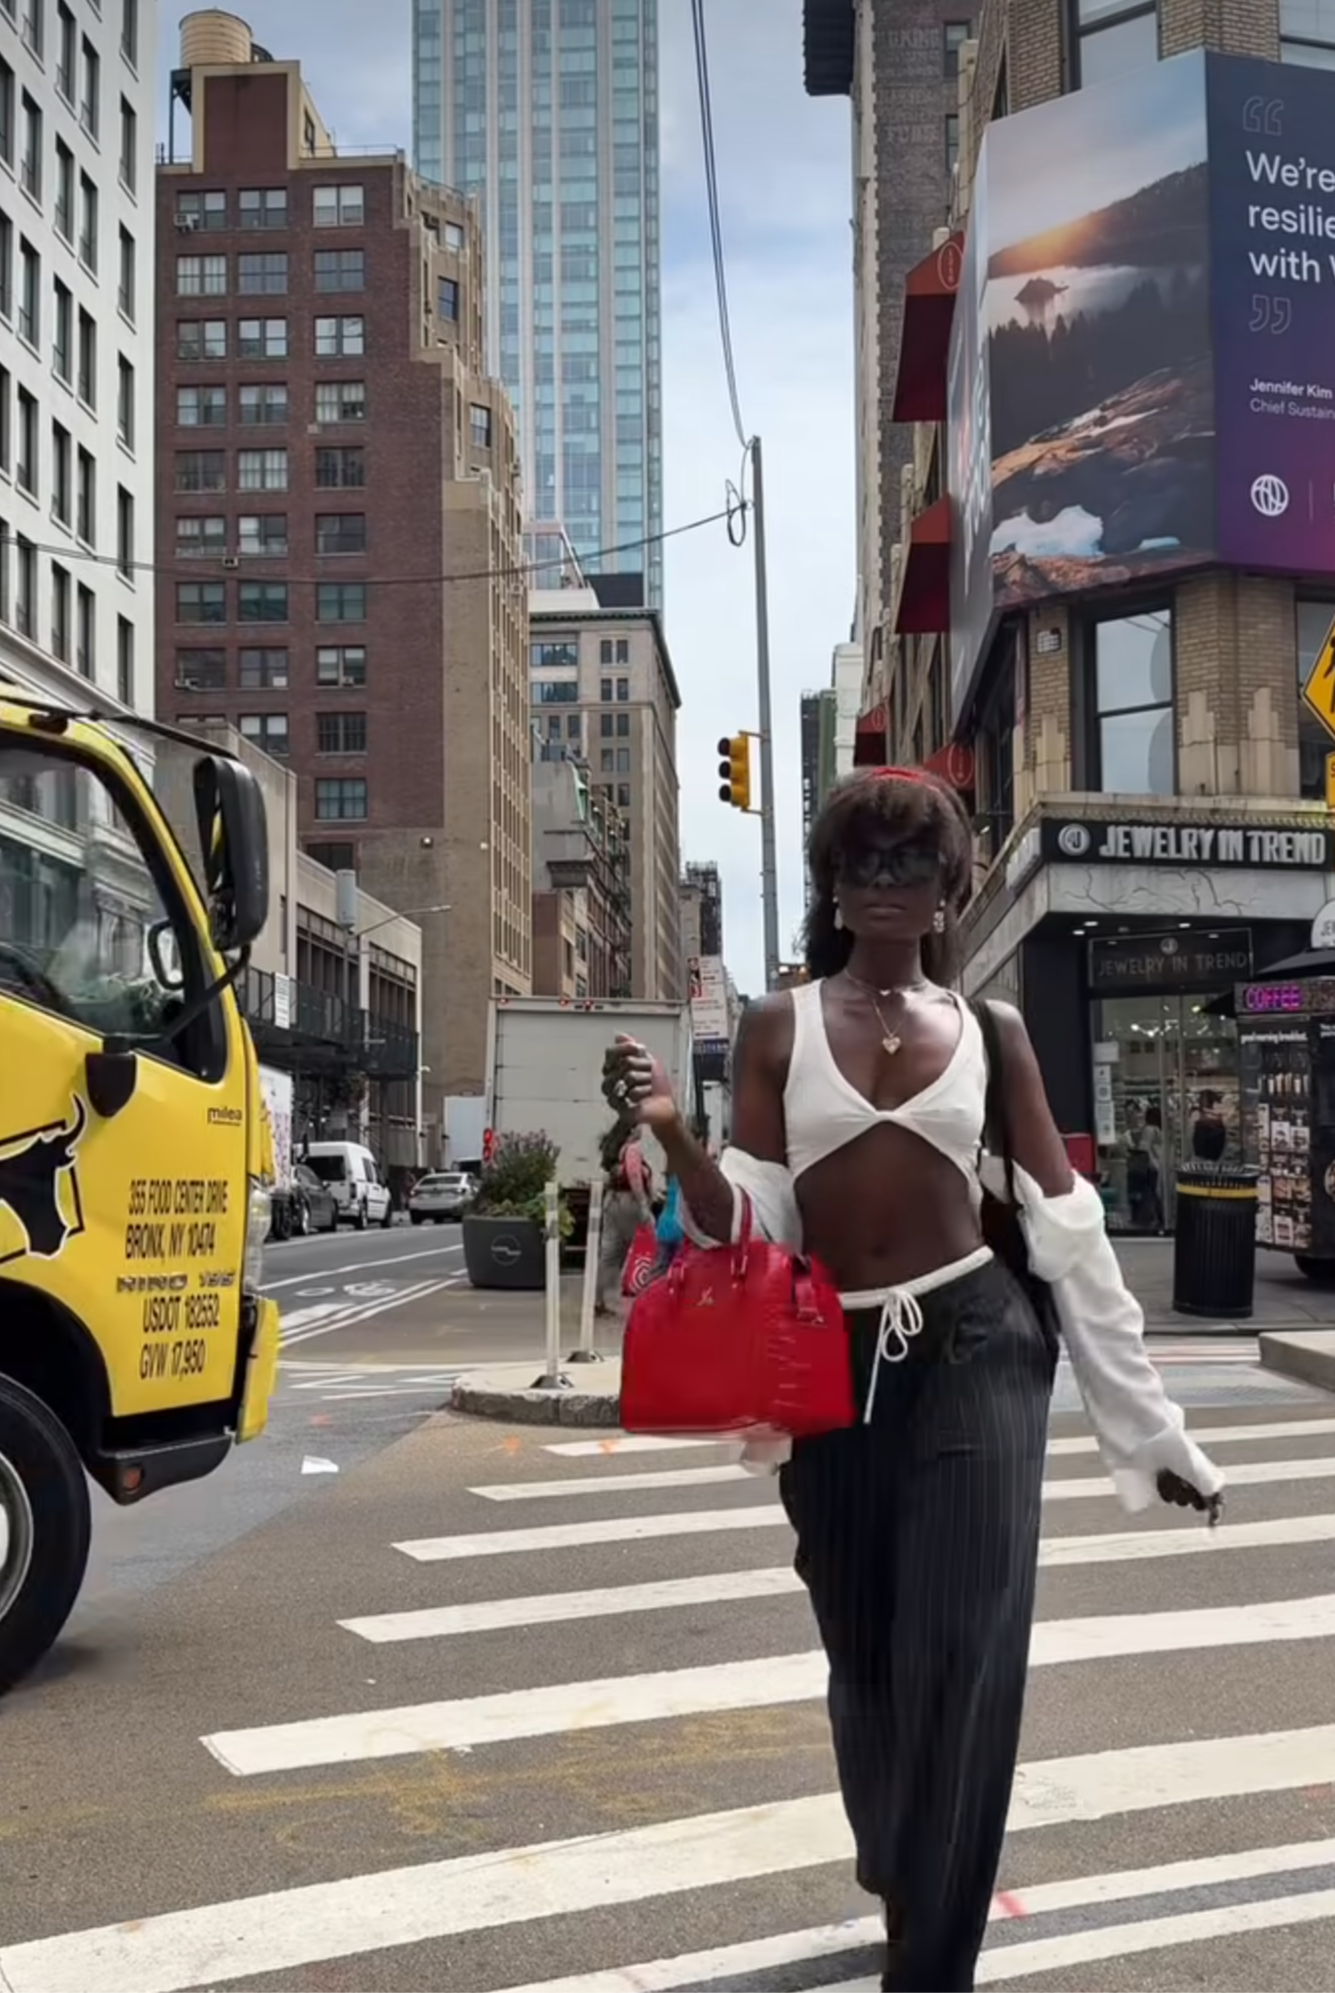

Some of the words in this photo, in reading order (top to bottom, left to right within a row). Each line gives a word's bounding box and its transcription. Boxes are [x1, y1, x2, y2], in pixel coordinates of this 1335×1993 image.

[1248, 247, 1321, 284] with
[1249, 378, 1304, 397] Jennifer
[1306, 384, 1333, 400] Kim
[1249, 397, 1286, 415] Chief
[1099, 825, 1216, 861] JEWELRY
[1217, 829, 1244, 862] IN
[1246, 831, 1326, 865] TREND
[1099, 955, 1166, 976] JEWELRY
[1172, 955, 1188, 972] IN
[1194, 952, 1248, 970] TREND
[1246, 984, 1300, 1009] COFFEE
[207, 1106, 242, 1123] milea
[147, 1179, 172, 1215] FOOD
[174, 1179, 205, 1215] CENTER
[205, 1179, 229, 1214] DRIVE
[168, 1223, 186, 1258] NY
[187, 1221, 216, 1257] 10474
[143, 1296, 181, 1333] USDOT
[139, 1342, 169, 1380] GVW
